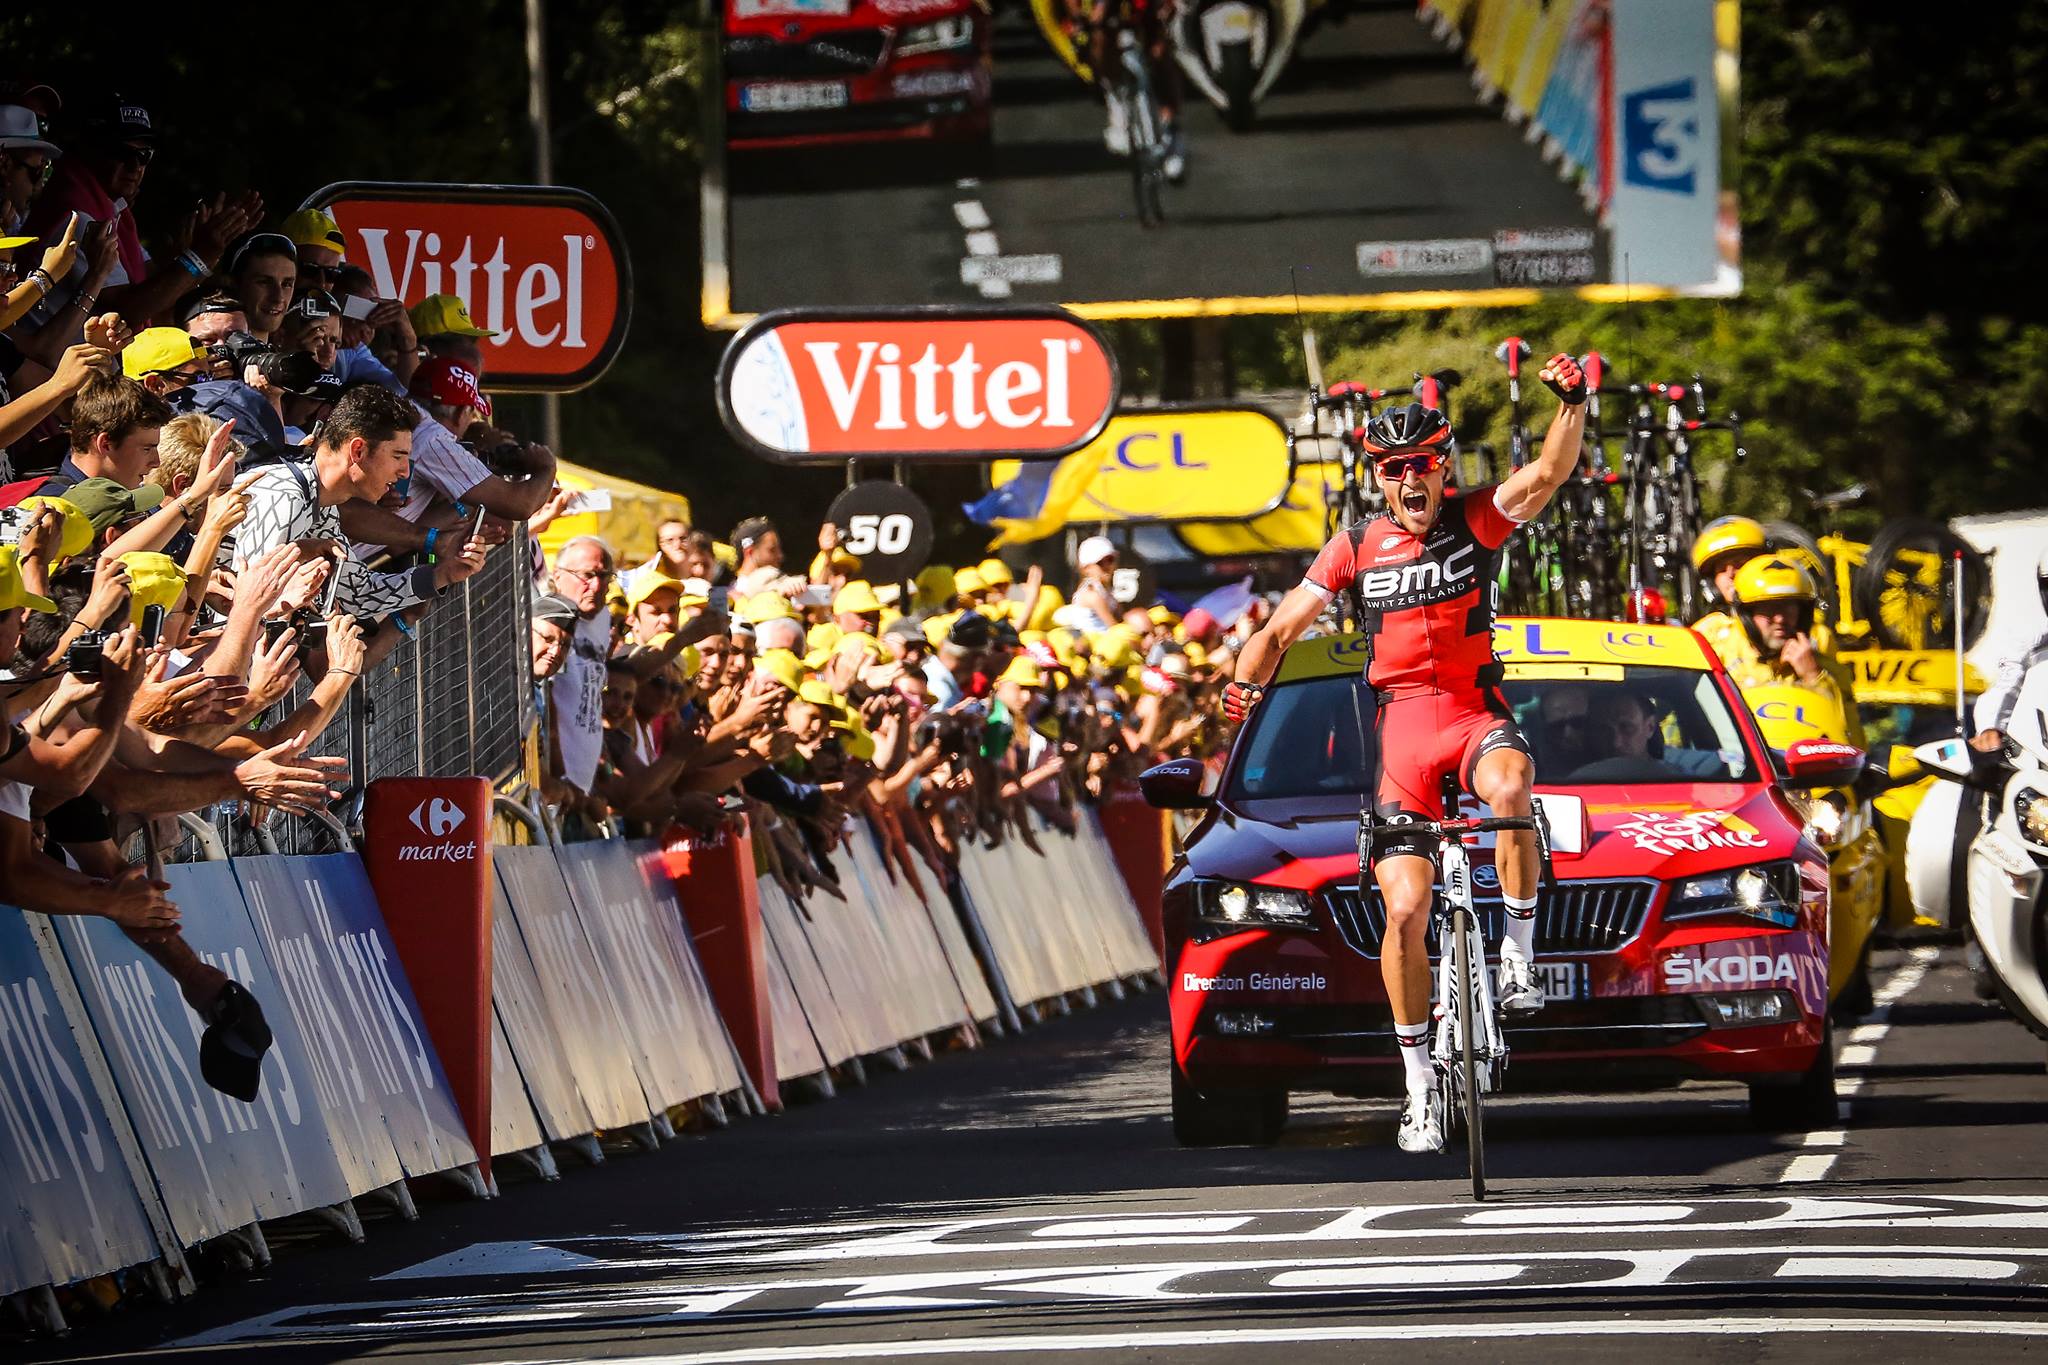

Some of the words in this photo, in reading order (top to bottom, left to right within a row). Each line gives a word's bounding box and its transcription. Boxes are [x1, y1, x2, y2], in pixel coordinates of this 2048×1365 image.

[1638, 99, 1698, 180] 3
[357, 228, 587, 349] Vittel
[804, 337, 1075, 430] Vittel
[1101, 432, 1207, 471] CL
[845, 513, 914, 556] 50
[1111, 567, 1141, 603] 5
[1363, 543, 1475, 598] BMC
[1367, 582, 1465, 609] SWITZERLAND
[1607, 631, 1667, 648] LCL
[398, 838, 477, 863] market
[1384, 844, 1415, 855] BMC
[1452, 859, 1464, 896] BMC
[1183, 973, 1244, 991] Direction
[1249, 971, 1327, 991] Générale
[1664, 953, 1798, 985] ŠKODA
[304, 879, 441, 1168] Krys
